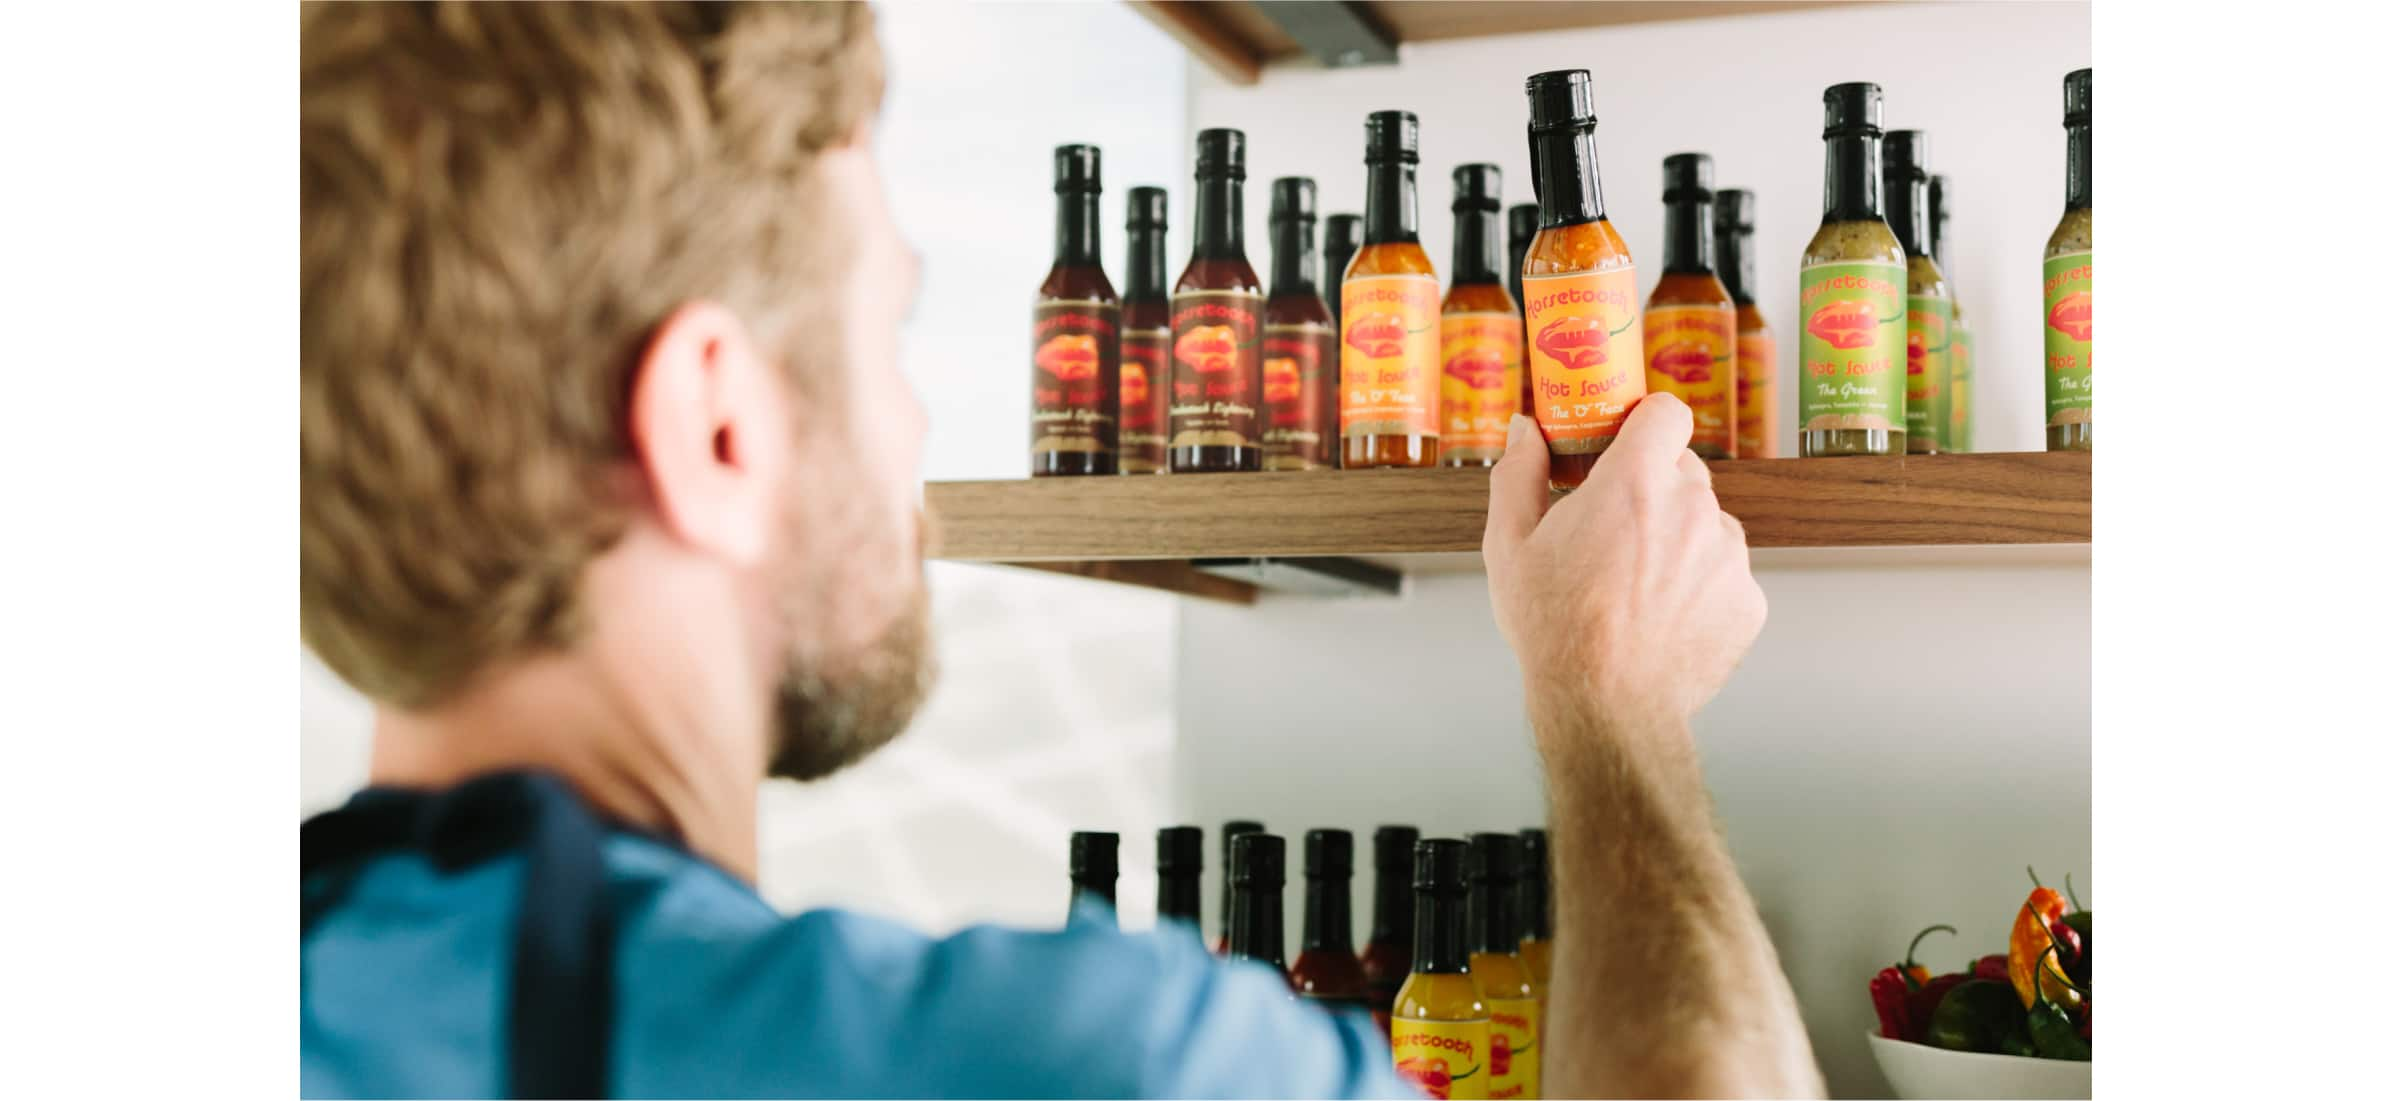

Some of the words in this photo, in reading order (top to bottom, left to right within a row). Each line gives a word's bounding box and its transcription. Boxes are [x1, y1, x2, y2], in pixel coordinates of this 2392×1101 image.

[1527, 288, 1627, 318] Horsetooth
[1807, 359, 1836, 378] Hot
[2048, 352, 2077, 374] Hot
[1540, 376, 1570, 400] Hot
[1579, 369, 1627, 397] Sauce
[1817, 383, 1837, 397] The
[1840, 381, 1879, 400] Green
[2059, 376, 2077, 391] The
[1550, 405, 1569, 419] The
[1594, 401, 1625, 417] Face
